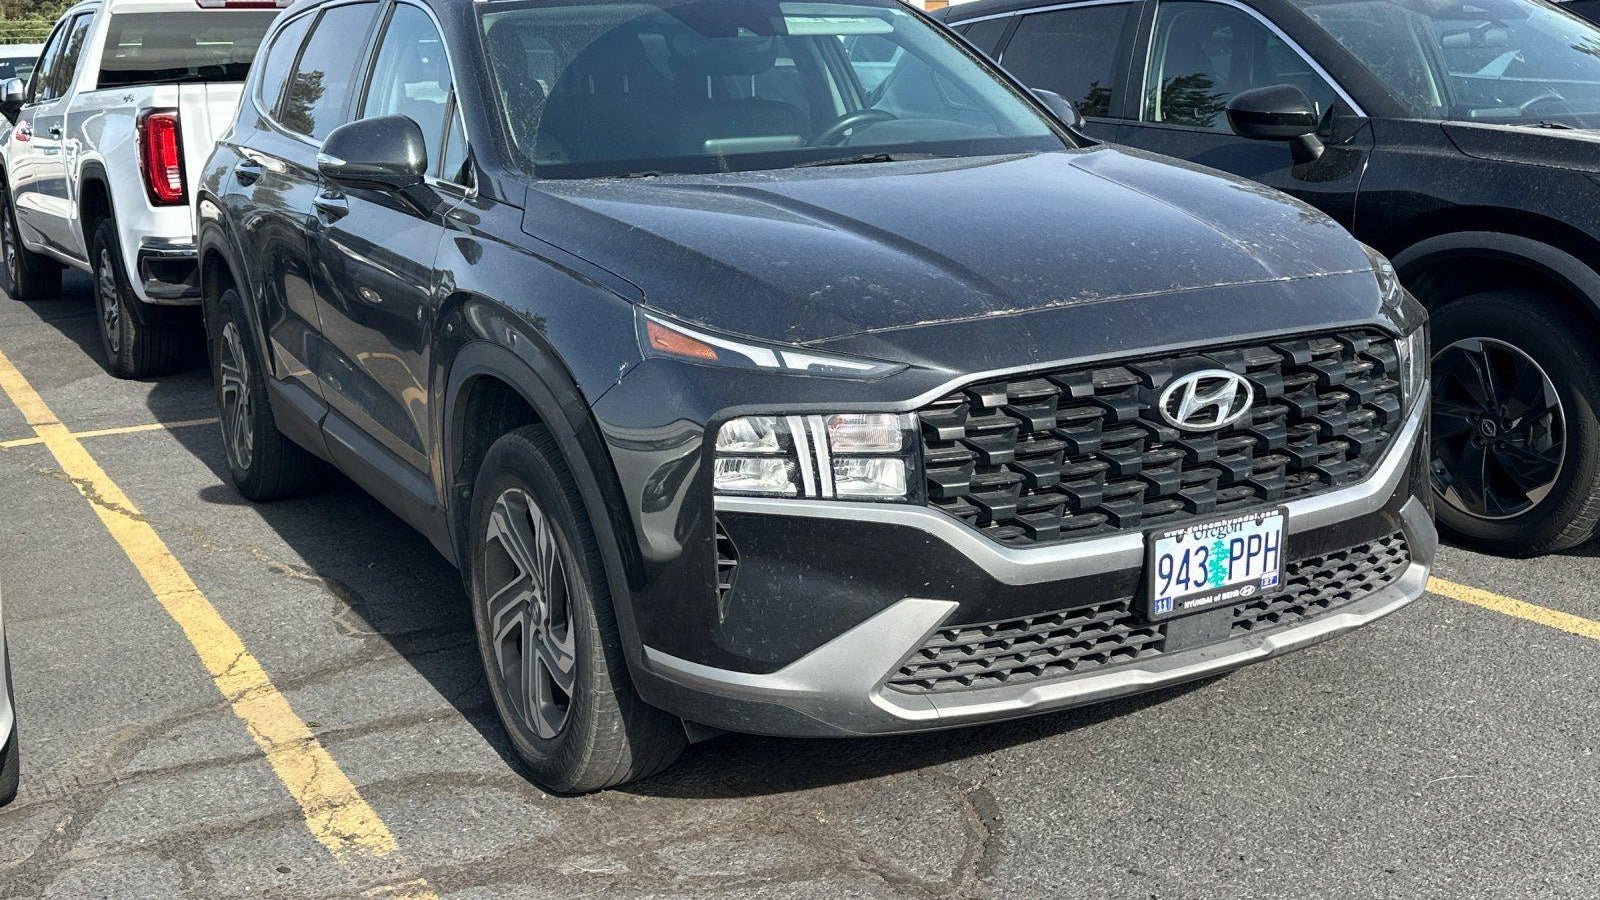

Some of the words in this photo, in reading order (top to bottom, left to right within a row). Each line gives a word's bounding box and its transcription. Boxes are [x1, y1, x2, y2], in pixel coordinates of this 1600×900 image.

[1158, 545, 1210, 597] 943
[1228, 530, 1281, 582] PPH
[1184, 596, 1214, 609] HYUNDAI
